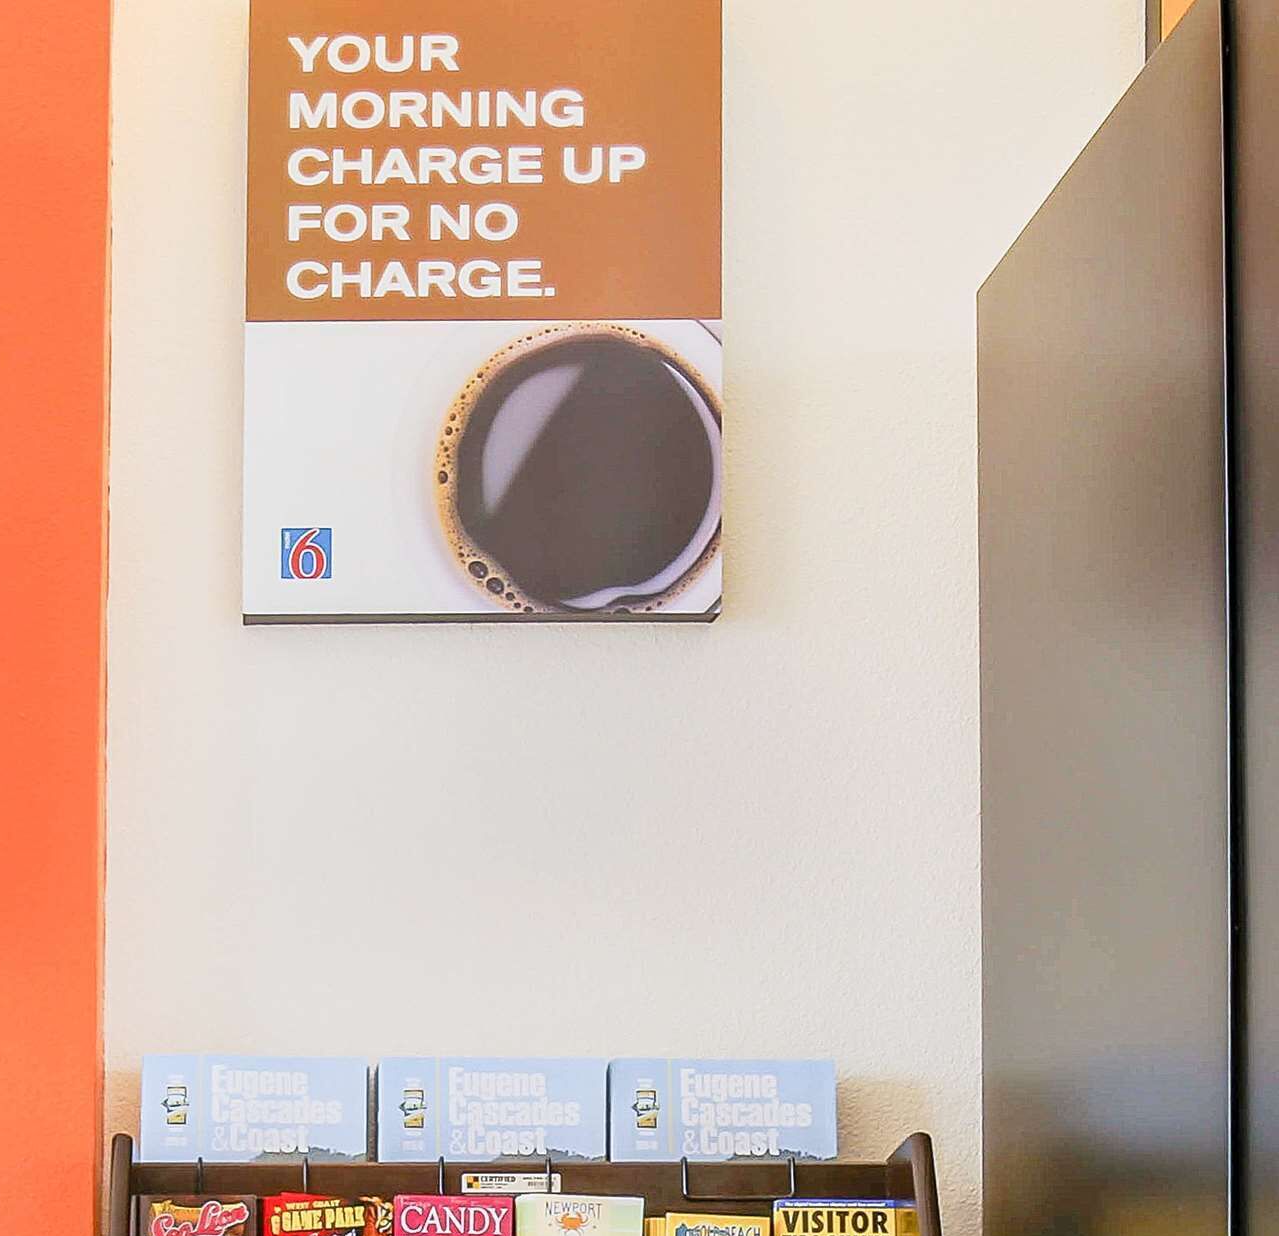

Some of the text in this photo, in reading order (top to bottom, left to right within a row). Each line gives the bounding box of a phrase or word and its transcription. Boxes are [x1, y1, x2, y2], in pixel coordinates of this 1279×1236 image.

[287, 34, 460, 73] YOUR
[288, 89, 585, 129] MORNING
[286, 146, 646, 186] CHARGE UP
[286, 203, 519, 242] FOR NO
[286, 260, 556, 299] CHARGE.
[288, 527, 327, 580] 6
[211, 1066, 310, 1100] Eugene
[448, 1067, 546, 1101] Eugene
[212, 1097, 343, 1126] Cascades
[448, 1097, 581, 1127] Cascades
[400, 1206, 506, 1235] CANDY
[545, 1201, 602, 1218] NEWPORT
[783, 1211, 888, 1234] VISITOR
